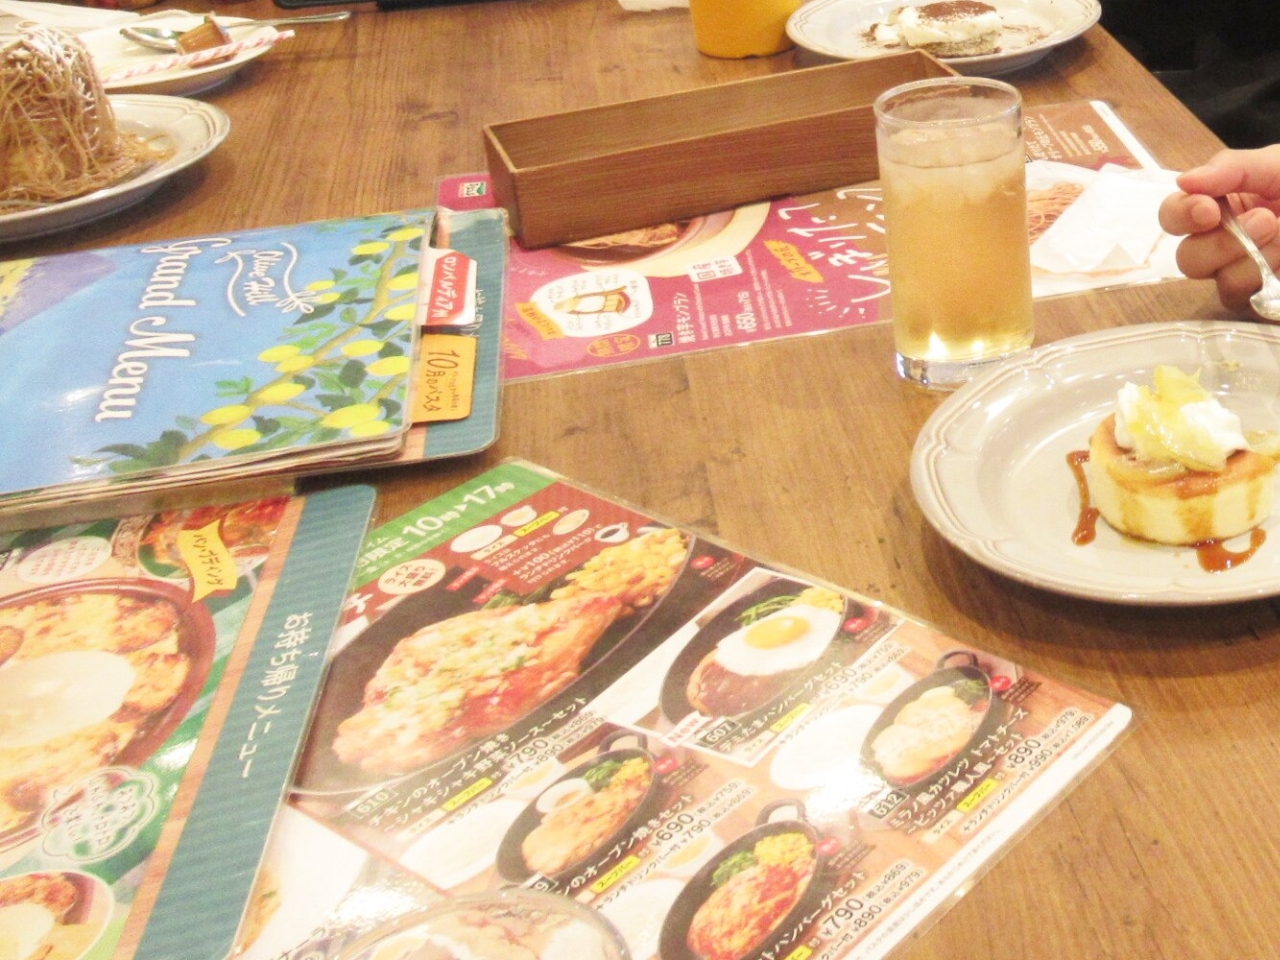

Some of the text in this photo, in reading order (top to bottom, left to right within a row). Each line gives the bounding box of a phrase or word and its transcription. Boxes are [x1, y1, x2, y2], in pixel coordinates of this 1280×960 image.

[95, 237, 232, 423] Grand Menu
[422, 350, 459, 412] 10月のパスタ
[240, 612, 314, 778] お持ち帰りメニュー
[718, 658, 845, 754] デミたまハンバーグセット
[503, 734, 549, 772] ¥790
[706, 719, 734, 744] 607
[970, 705, 1030, 759] トマトチーズ
[1003, 735, 1042, 771] ¥890
[368, 726, 510, 831] チキンのオーブン焼き
[872, 790, 902, 817] 612
[553, 790, 696, 899] ンのオーブン焼きセット
[647, 809, 695, 850] ¥690
[757, 867, 867, 960] トハンバーグセット
[818, 894, 864, 938] ¥790
[849, 901, 882, 934] ¥890
